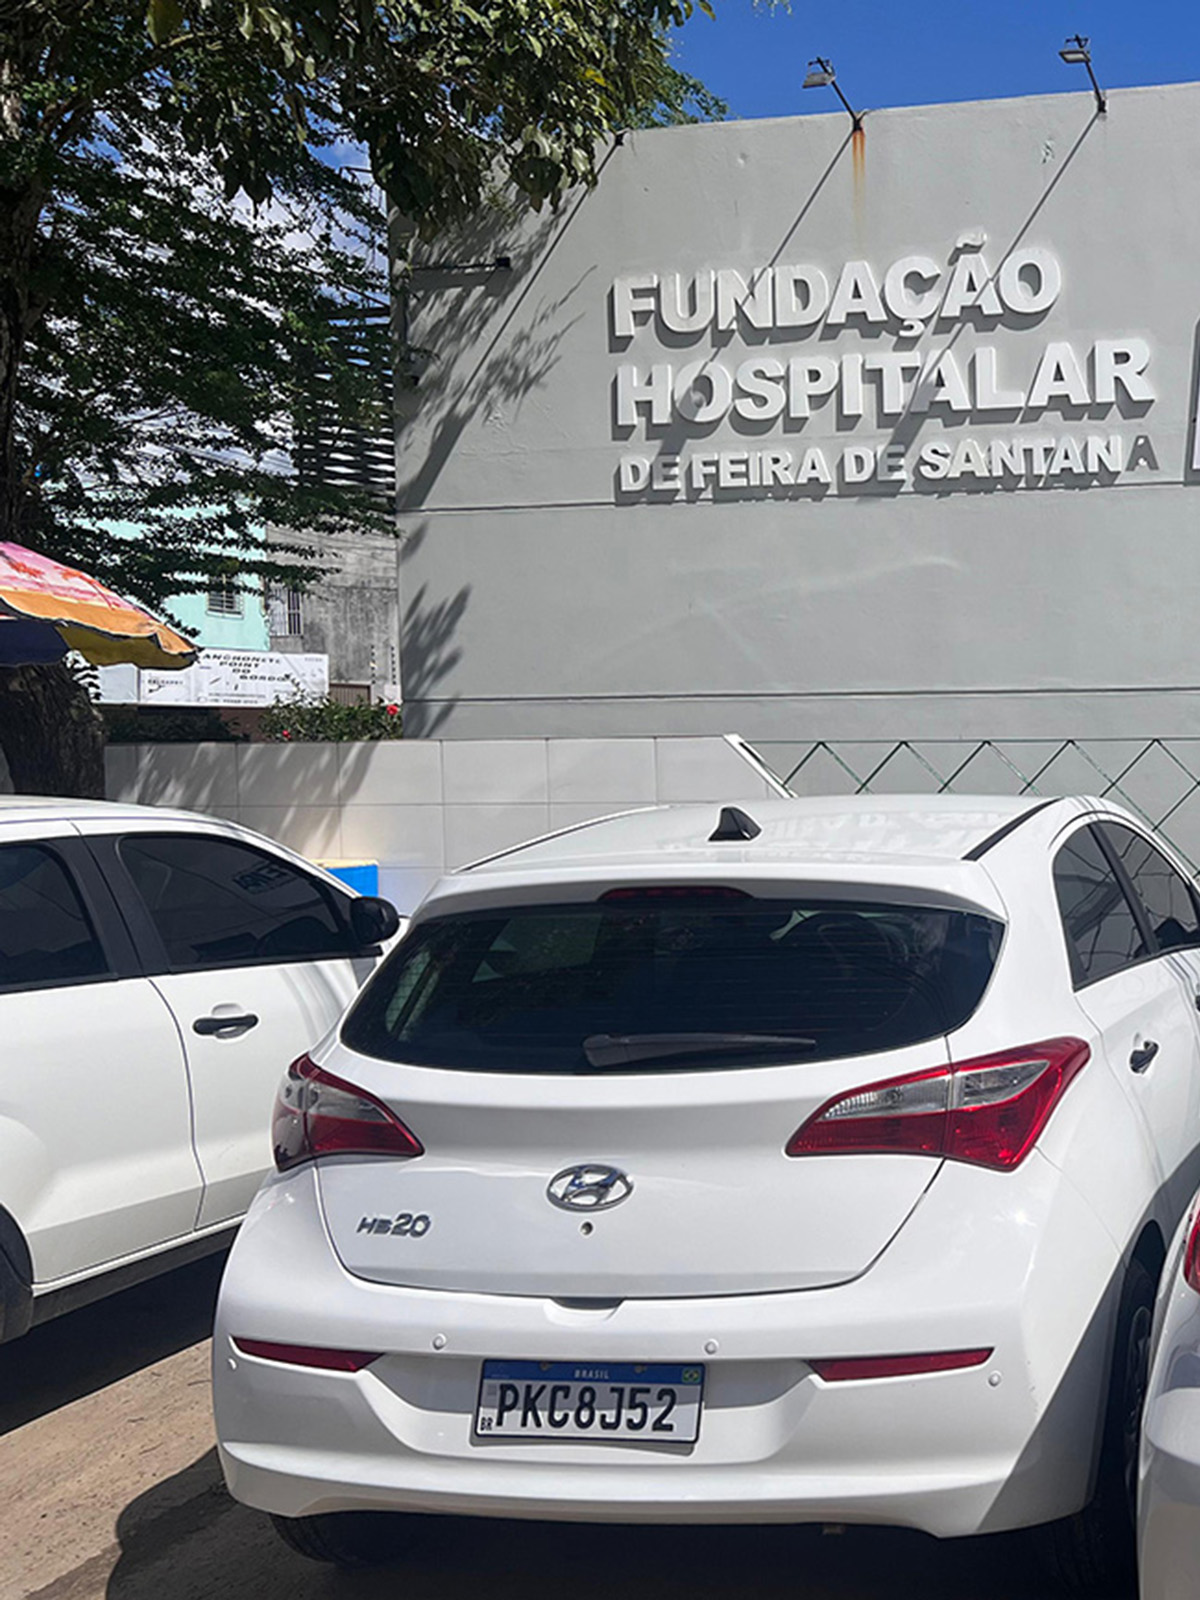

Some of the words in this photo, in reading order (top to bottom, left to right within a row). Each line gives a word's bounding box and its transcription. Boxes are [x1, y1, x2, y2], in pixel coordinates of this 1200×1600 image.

[612, 231, 1063, 338] FUNDAÇÃO
[615, 338, 1156, 426] HOSPITALAR
[619, 454, 682, 492] DE
[692, 447, 833, 489] FEIRA
[843, 445, 907, 482] DE
[919, 435, 1160, 480] SANTANA
[356, 1212, 432, 1238] HB20
[573, 1369, 611, 1380] BRASIL
[479, 1416, 493, 1432] BR
[495, 1383, 678, 1433] PKC8J52
